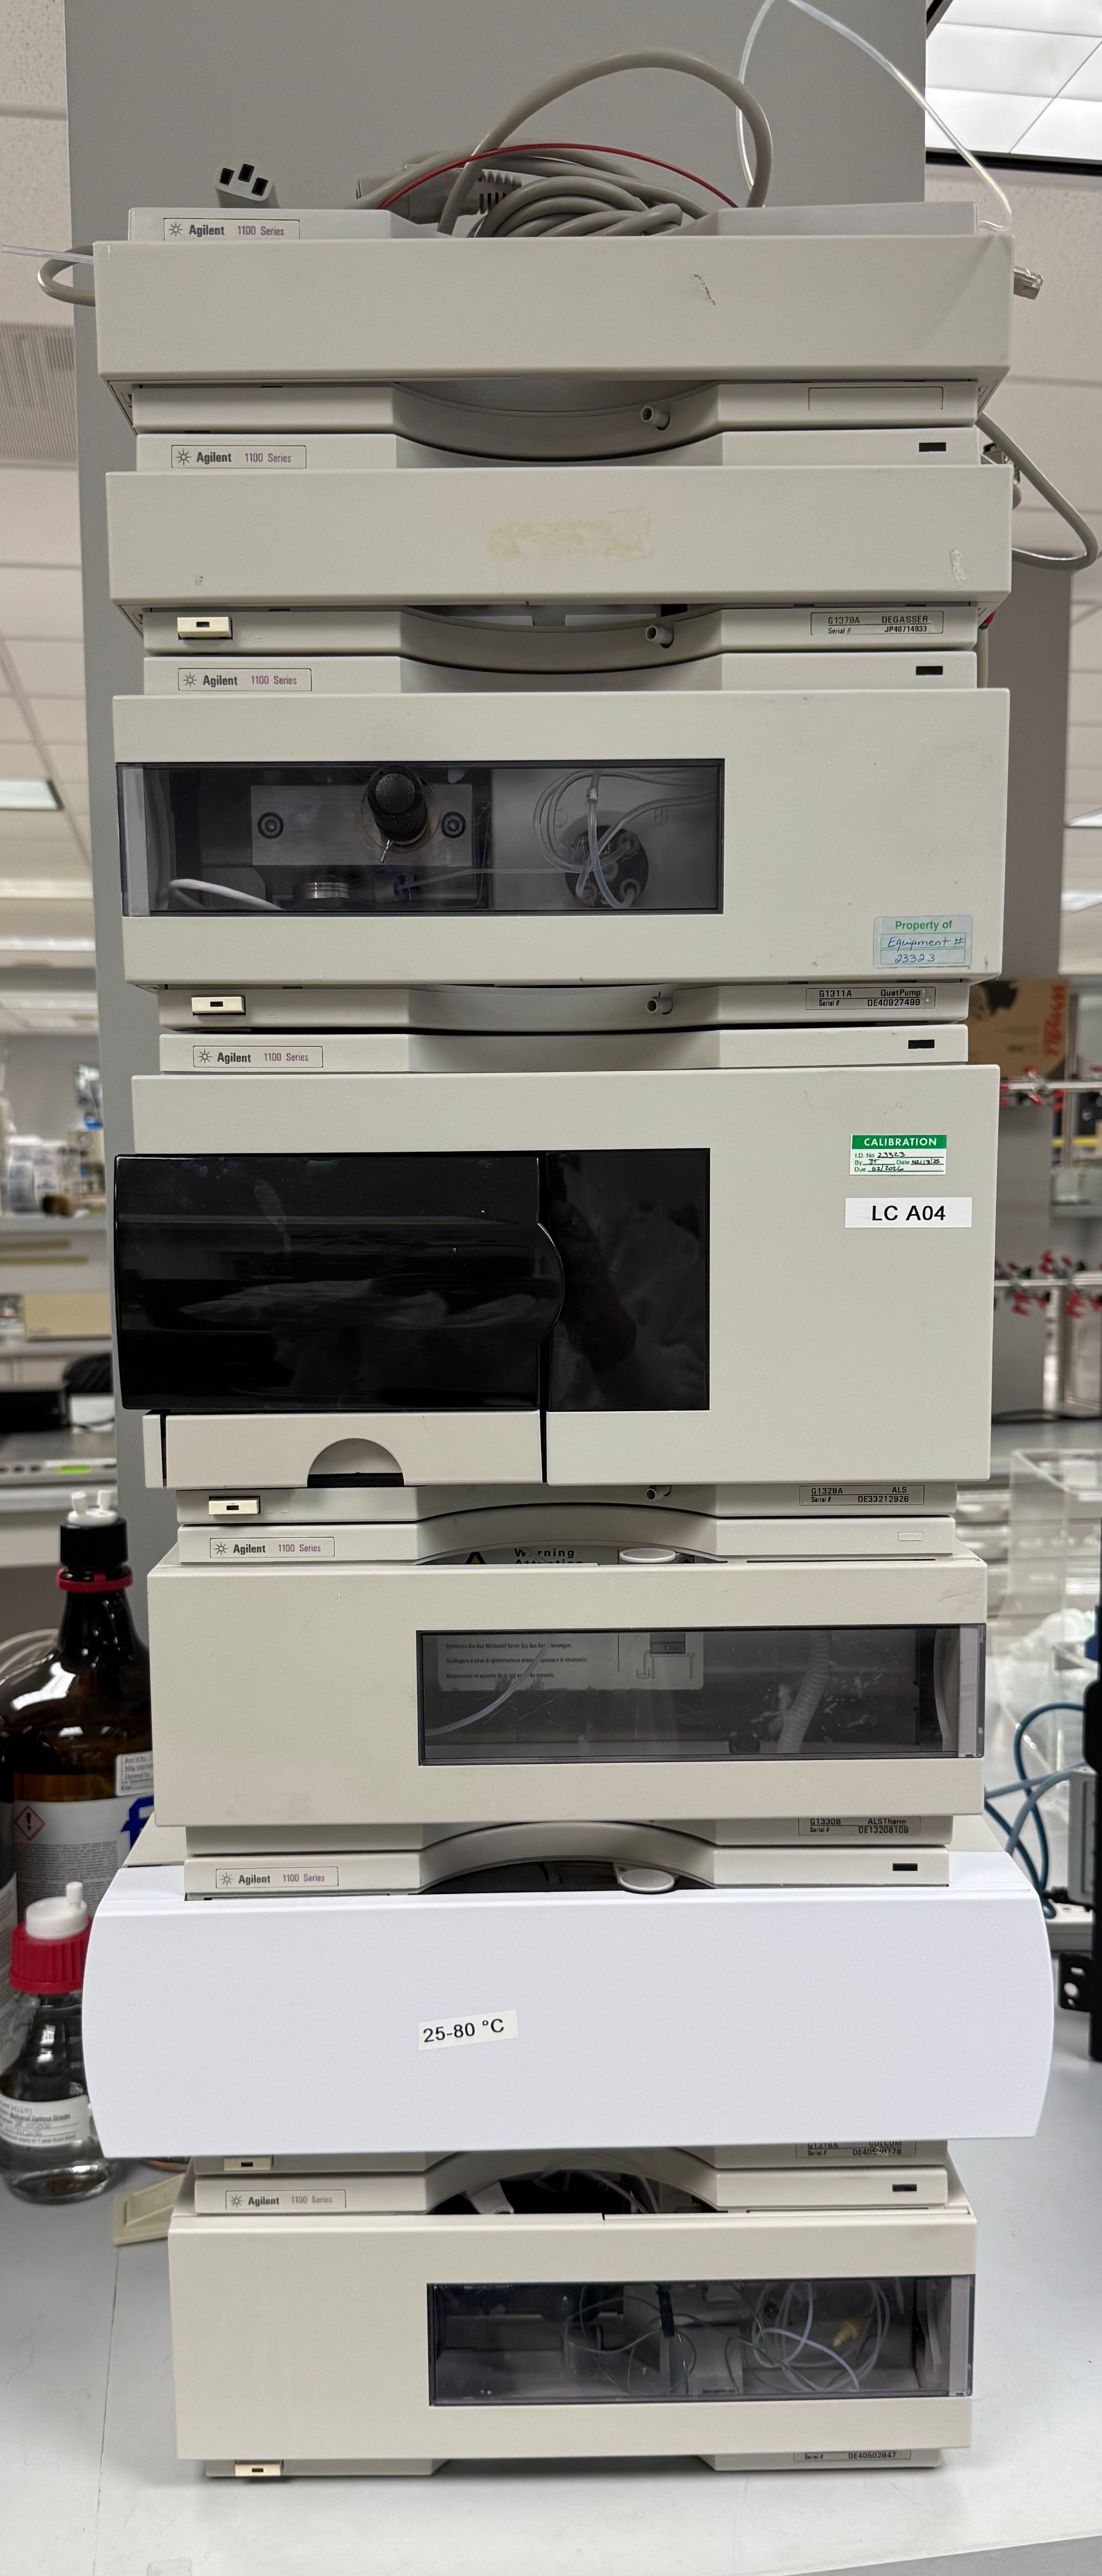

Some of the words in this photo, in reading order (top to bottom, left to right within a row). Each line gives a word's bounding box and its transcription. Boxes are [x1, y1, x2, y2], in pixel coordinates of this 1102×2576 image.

[189, 224, 225, 237] Agilent
[237, 226, 255, 236] 1100
[261, 226, 284, 236] Series
[197, 452, 232, 464] Agilent
[245, 453, 263, 462] 1100
[268, 453, 291, 463] Series
[203, 675, 238, 688] Agilent
[251, 676, 269, 685] 1100
[274, 676, 297, 685] Series
[895, 921, 939, 931] Property
[942, 920, 953, 929] of
[887, 937, 951, 952] Equipment
[954, 938, 966, 946] #
[895, 954, 935, 963] 23323
[217, 1052, 251, 1064] Agilent
[264, 1053, 281, 1062] 1100
[286, 1053, 308, 1062] Series
[864, 1138, 937, 1146] CALIBRATION
[872, 1205, 898, 1221] LC
[905, 1205, 945, 1221] A04
[233, 1544, 266, 1555] Agilent
[299, 1544, 321, 1552] Series
[514, 1548, 574, 1558] Wrning
[238, 1874, 271, 1885] Agilent
[283, 1874, 299, 1882] 1100
[304, 1873, 325, 1882] Series
[423, 2023, 475, 2043] 25-80
[482, 2018, 504, 2032] °C
[248, 2196, 280, 2207] Agilent
[291, 2195, 307, 2204] 1100
[312, 2195, 333, 2204] Series
